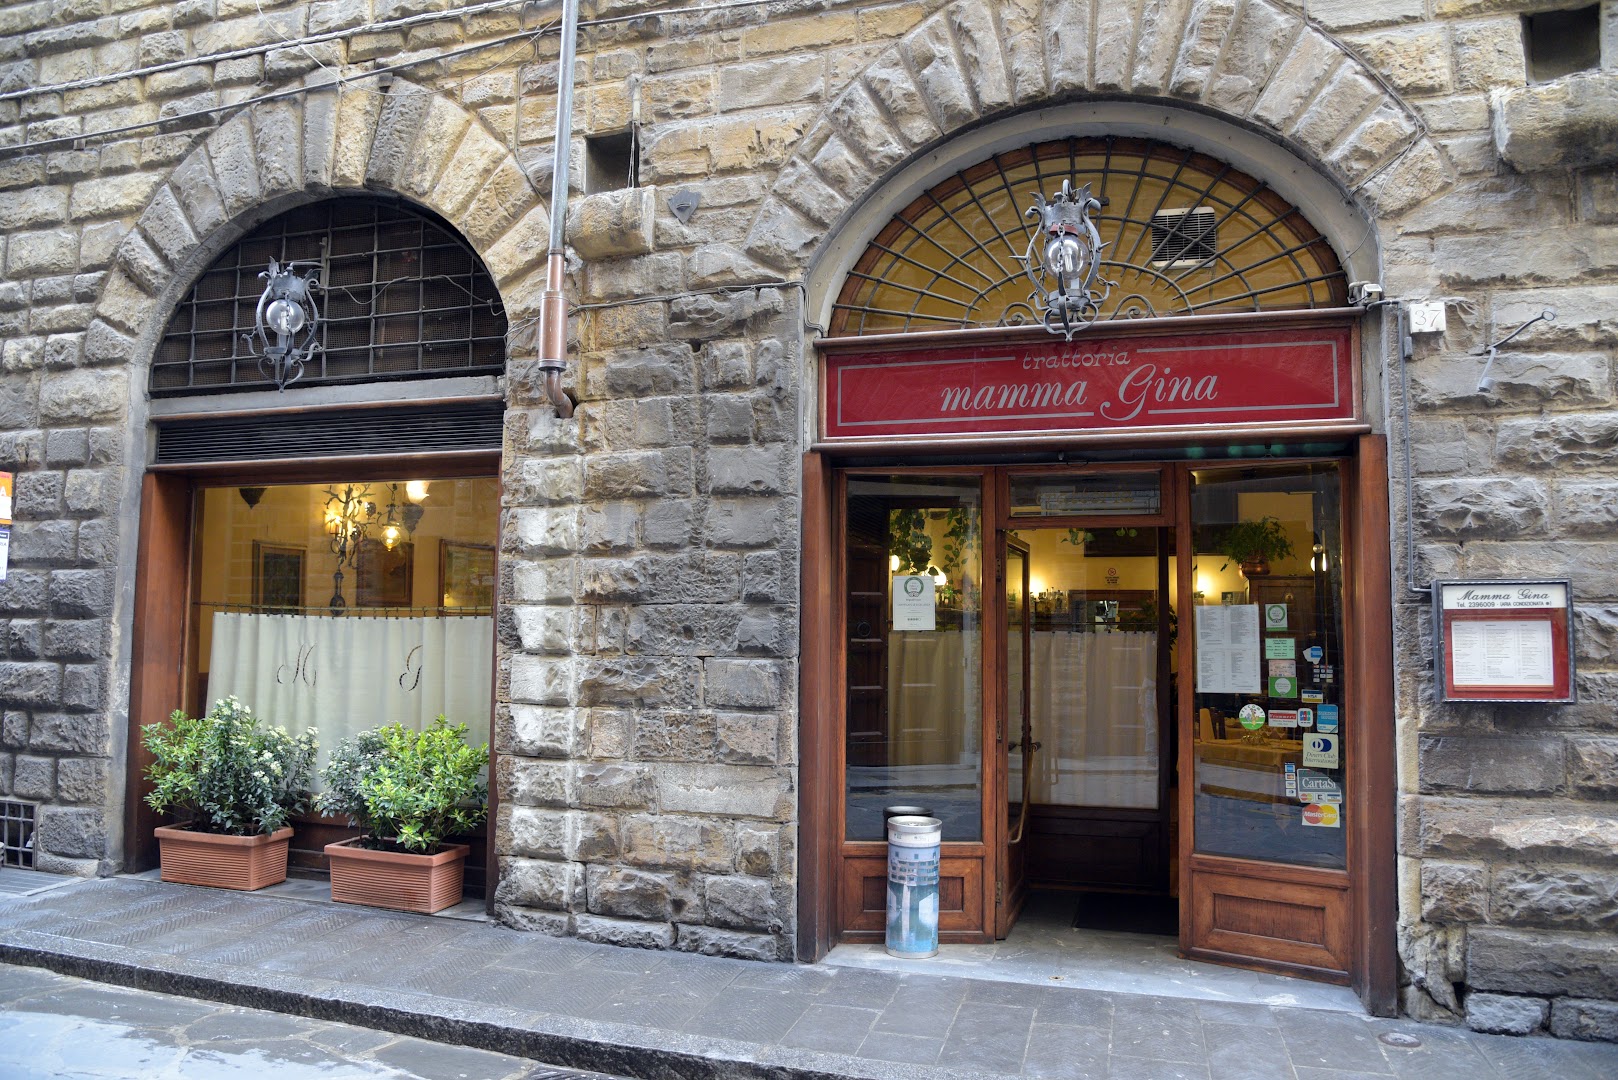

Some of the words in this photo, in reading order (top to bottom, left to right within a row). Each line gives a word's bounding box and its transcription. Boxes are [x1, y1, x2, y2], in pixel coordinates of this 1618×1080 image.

[1415, 310, 1440, 327] 37
[1022, 346, 1131, 370] trattoria
[940, 380, 1088, 412] mamma
[1100, 363, 1218, 422] Gina
[1457, 590, 1511, 600] Mamma
[1518, 589, 1549, 599] Gina
[276, 643, 317, 687] M
